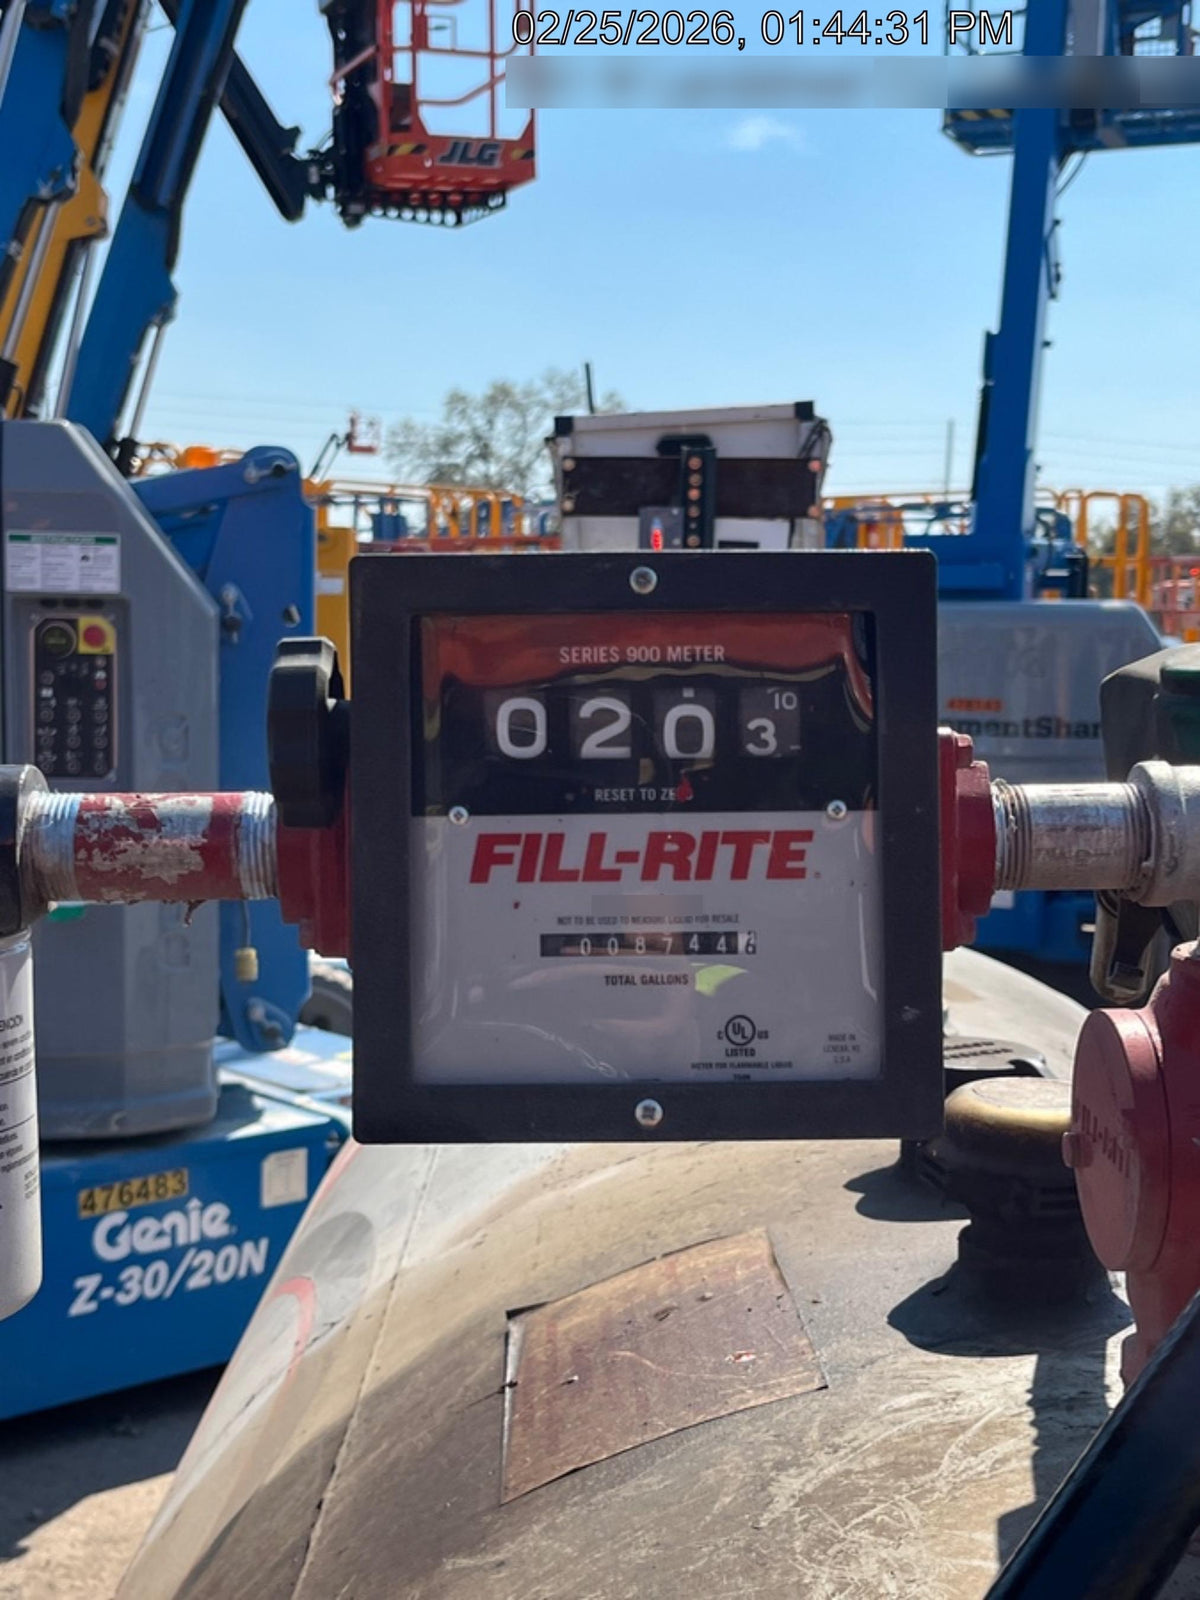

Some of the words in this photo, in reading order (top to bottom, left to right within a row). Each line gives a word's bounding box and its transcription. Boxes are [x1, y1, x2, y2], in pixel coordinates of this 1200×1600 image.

[436, 140, 503, 168] JLG
[559, 645, 620, 664] SERIES
[626, 645, 661, 663] 900
[666, 644, 726, 663] METER
[594, 788, 635, 802] RESET
[640, 788, 657, 801] TO
[469, 829, 814, 884] FILL-RITE
[557, 916, 573, 926] NOT
[574, 916, 584, 926] TO
[598, 916, 617, 926] USED
[712, 914, 739, 924] RESALE
[604, 975, 637, 987] TOTAL
[640, 974, 689, 986] GALLONS
[725, 1048, 756, 1057] LISTED
[81, 1170, 187, 1214] 476483
[92, 1197, 231, 1262] Genie
[67, 1237, 269, 1318] Z-30/20N
